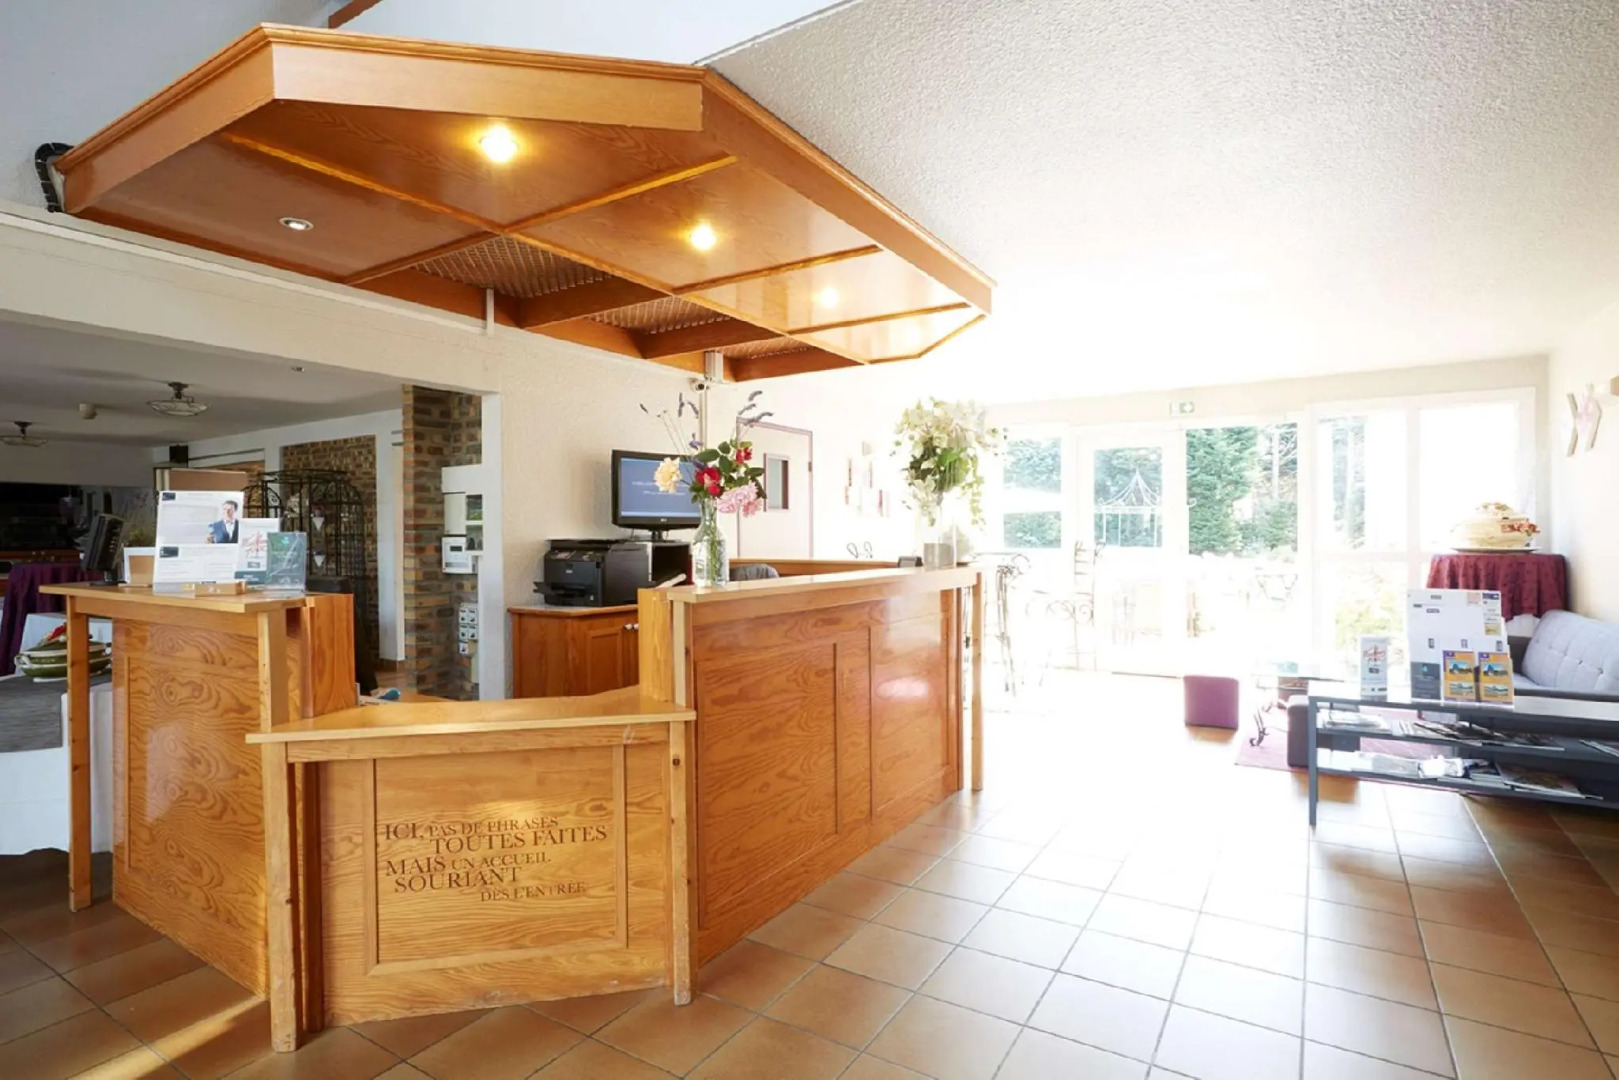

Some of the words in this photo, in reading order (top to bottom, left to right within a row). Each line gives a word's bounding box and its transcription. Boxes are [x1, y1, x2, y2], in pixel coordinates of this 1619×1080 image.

[430, 825, 457, 837] PAS
[462, 822, 481, 835] DE
[487, 816, 559, 833] PHRASES
[430, 832, 526, 855] TOUTES
[532, 825, 607, 847] FAITES
[386, 855, 446, 876] MAIS
[452, 858, 475, 870] UN
[481, 852, 551, 868] ACCUEIL
[395, 867, 522, 893] SOURIANT
